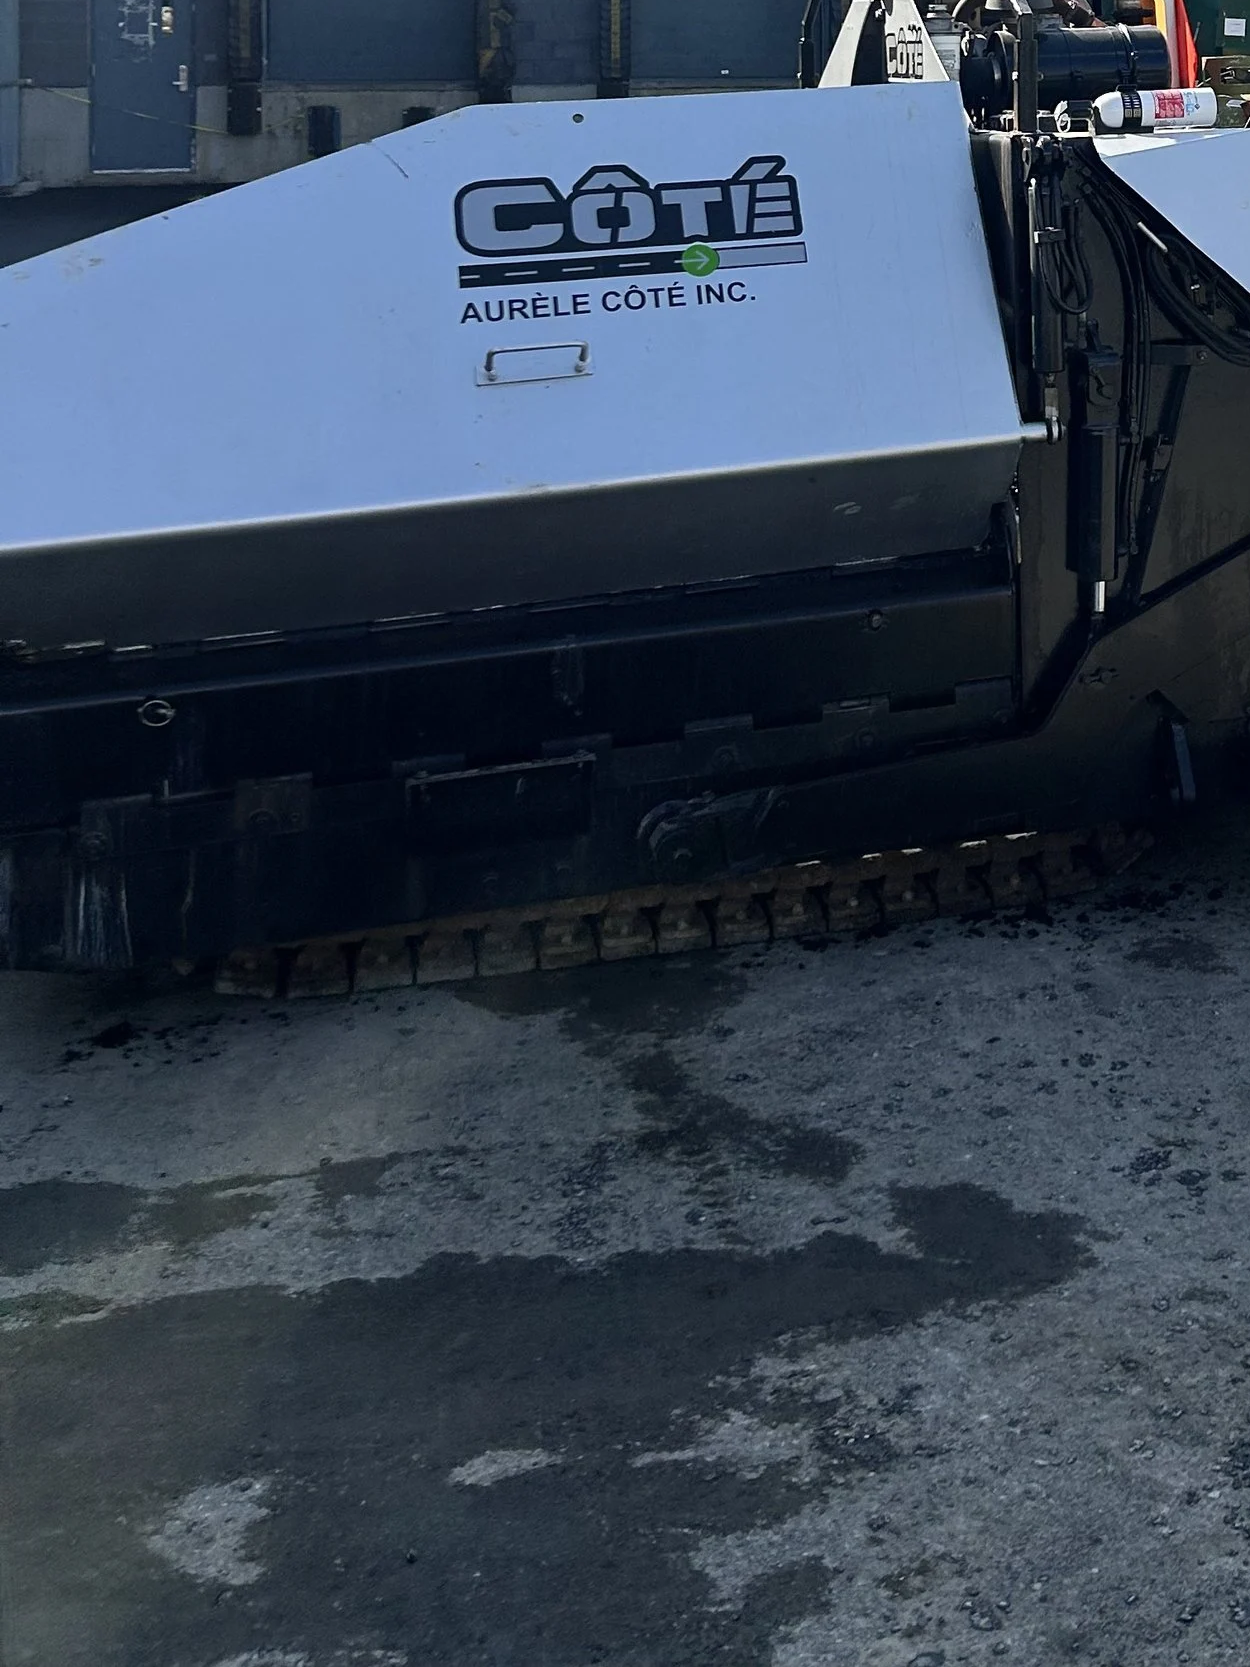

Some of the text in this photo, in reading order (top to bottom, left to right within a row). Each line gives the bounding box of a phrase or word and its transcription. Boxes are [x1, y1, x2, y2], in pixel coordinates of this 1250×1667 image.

[454, 155, 804, 257] CÔTÉ
[460, 281, 756, 324] AURÈLE CÔTÉ INC.
